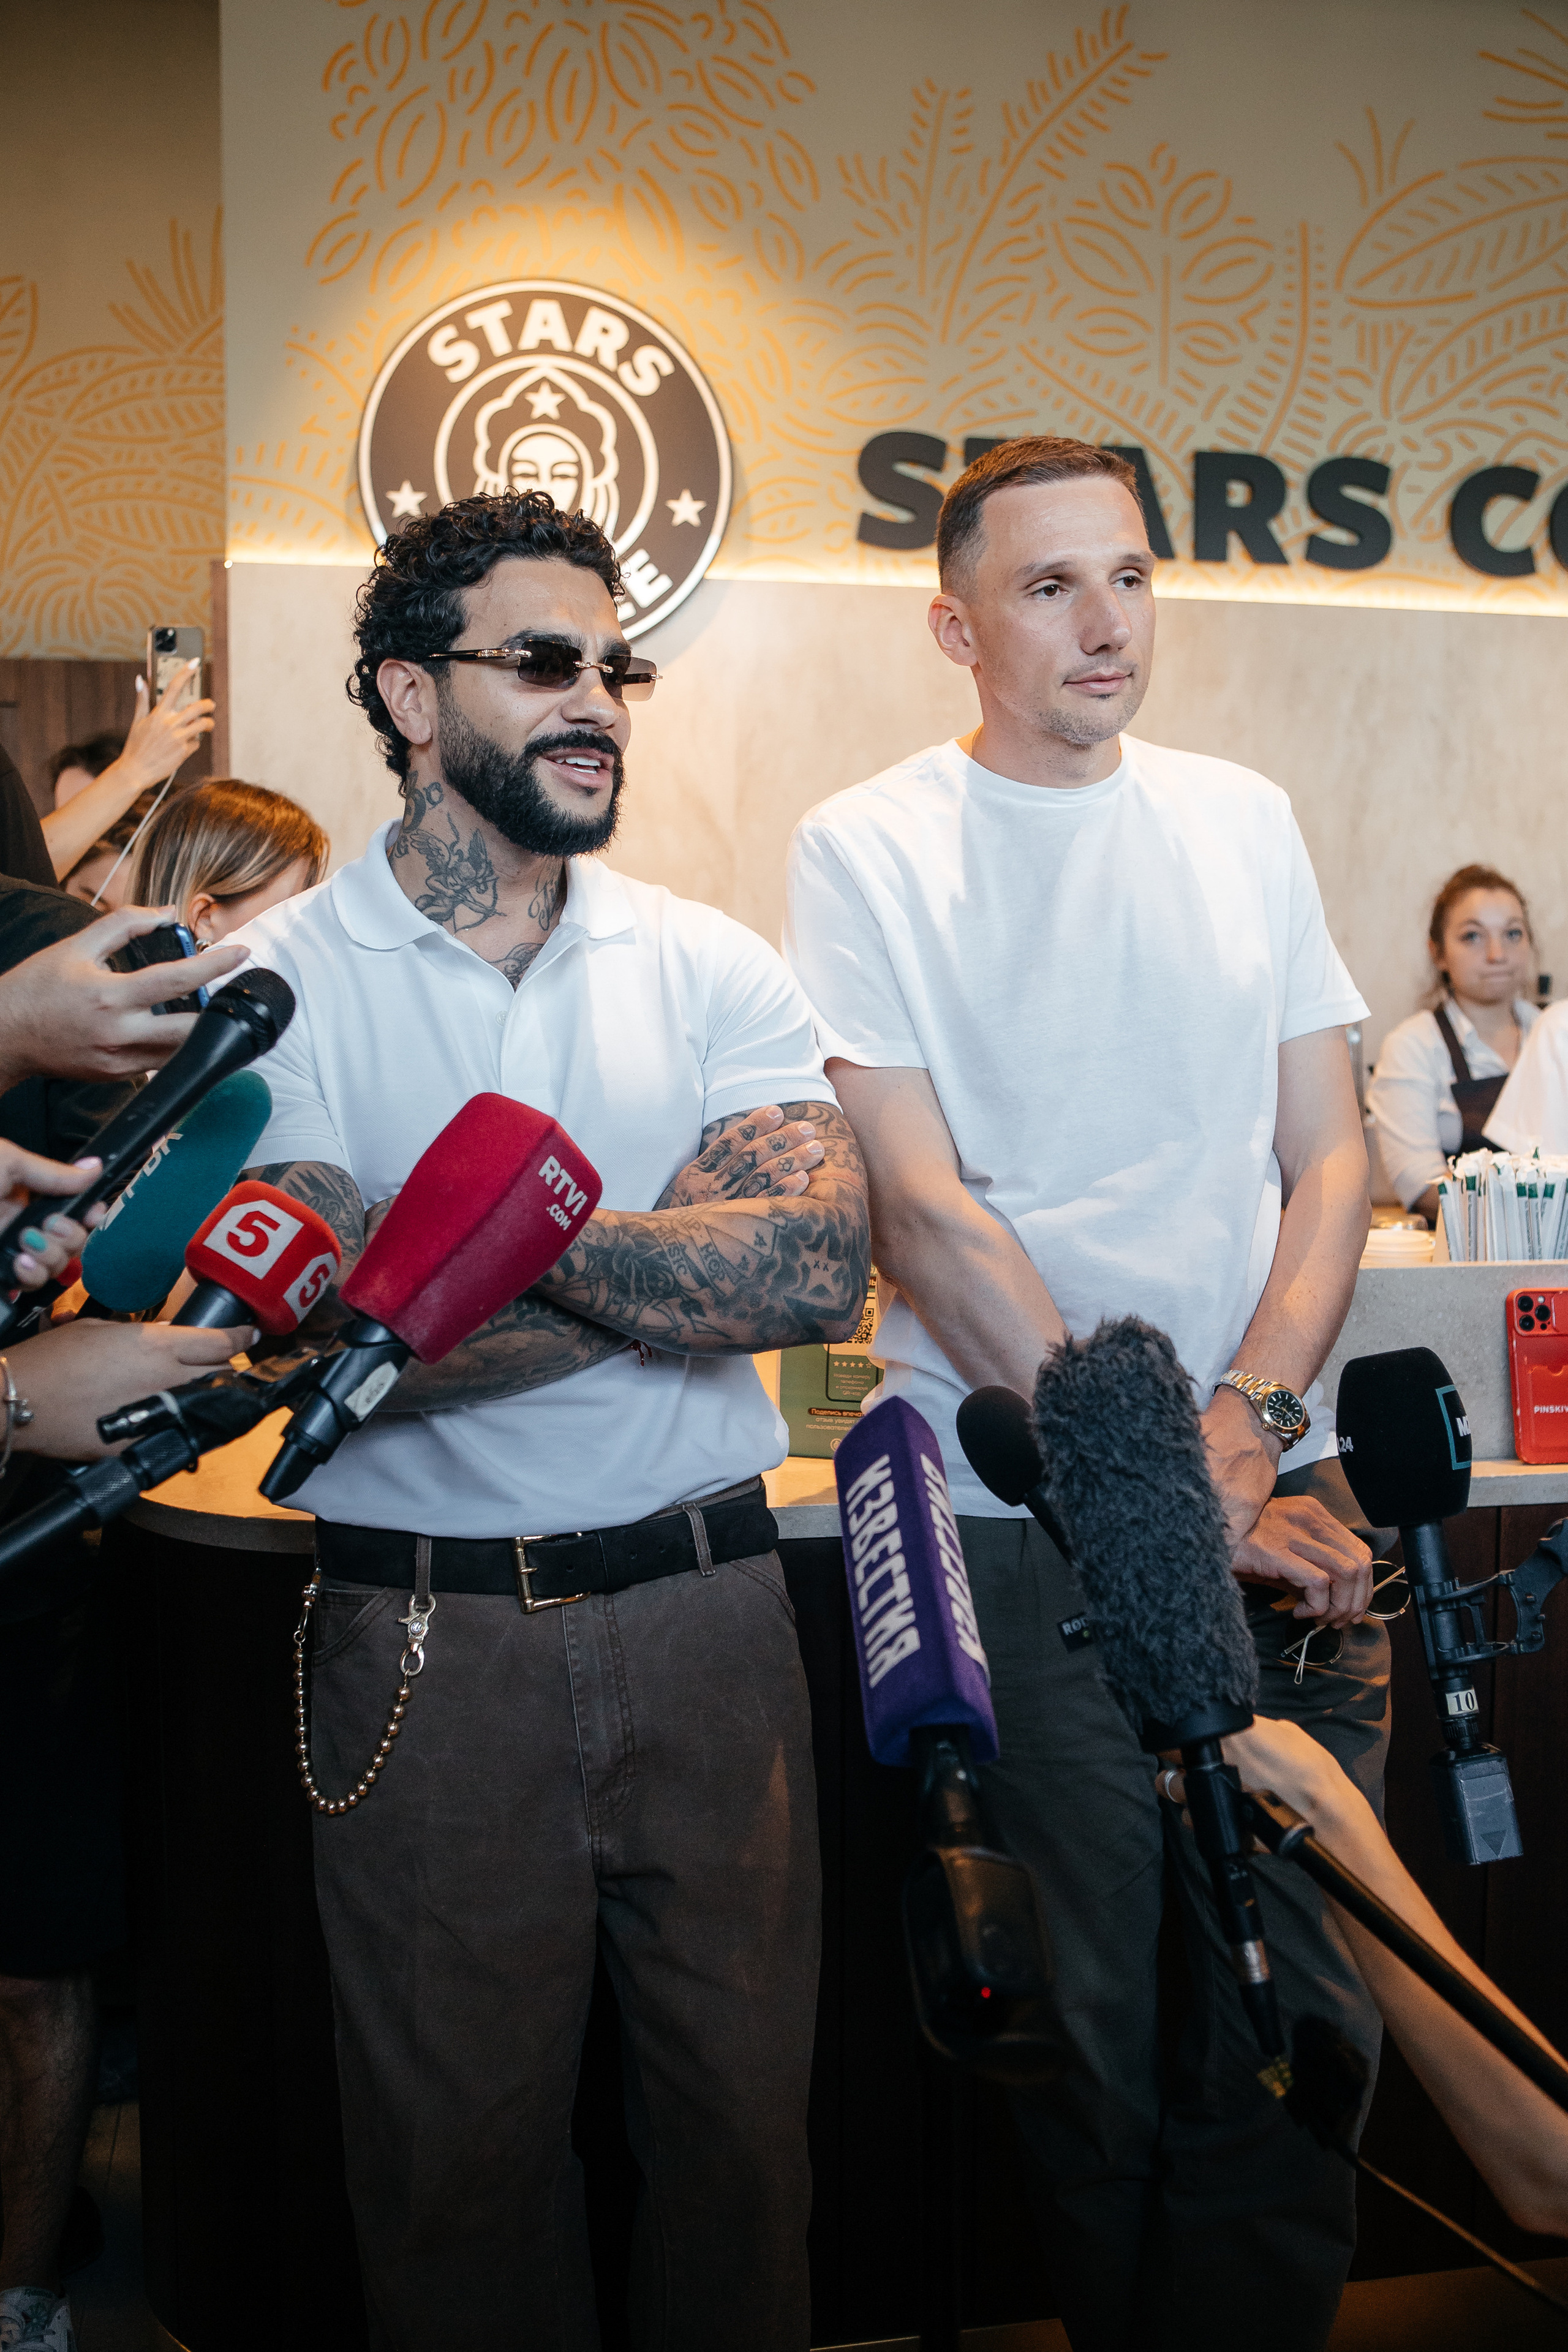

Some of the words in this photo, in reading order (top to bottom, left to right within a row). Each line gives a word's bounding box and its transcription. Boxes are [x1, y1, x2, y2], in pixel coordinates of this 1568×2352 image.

[428, 299, 675, 397] STARS
[856, 431, 1393, 571] SRS
[1452, 467, 1568, 578] C
[226, 1210, 281, 1258] 5
[546, 1204, 572, 1231] .COM
[299, 1264, 330, 1308] 5
[845, 1453, 921, 1689] ИЗВЕСТИЯ
[1453, 1691, 1475, 1712] 10
